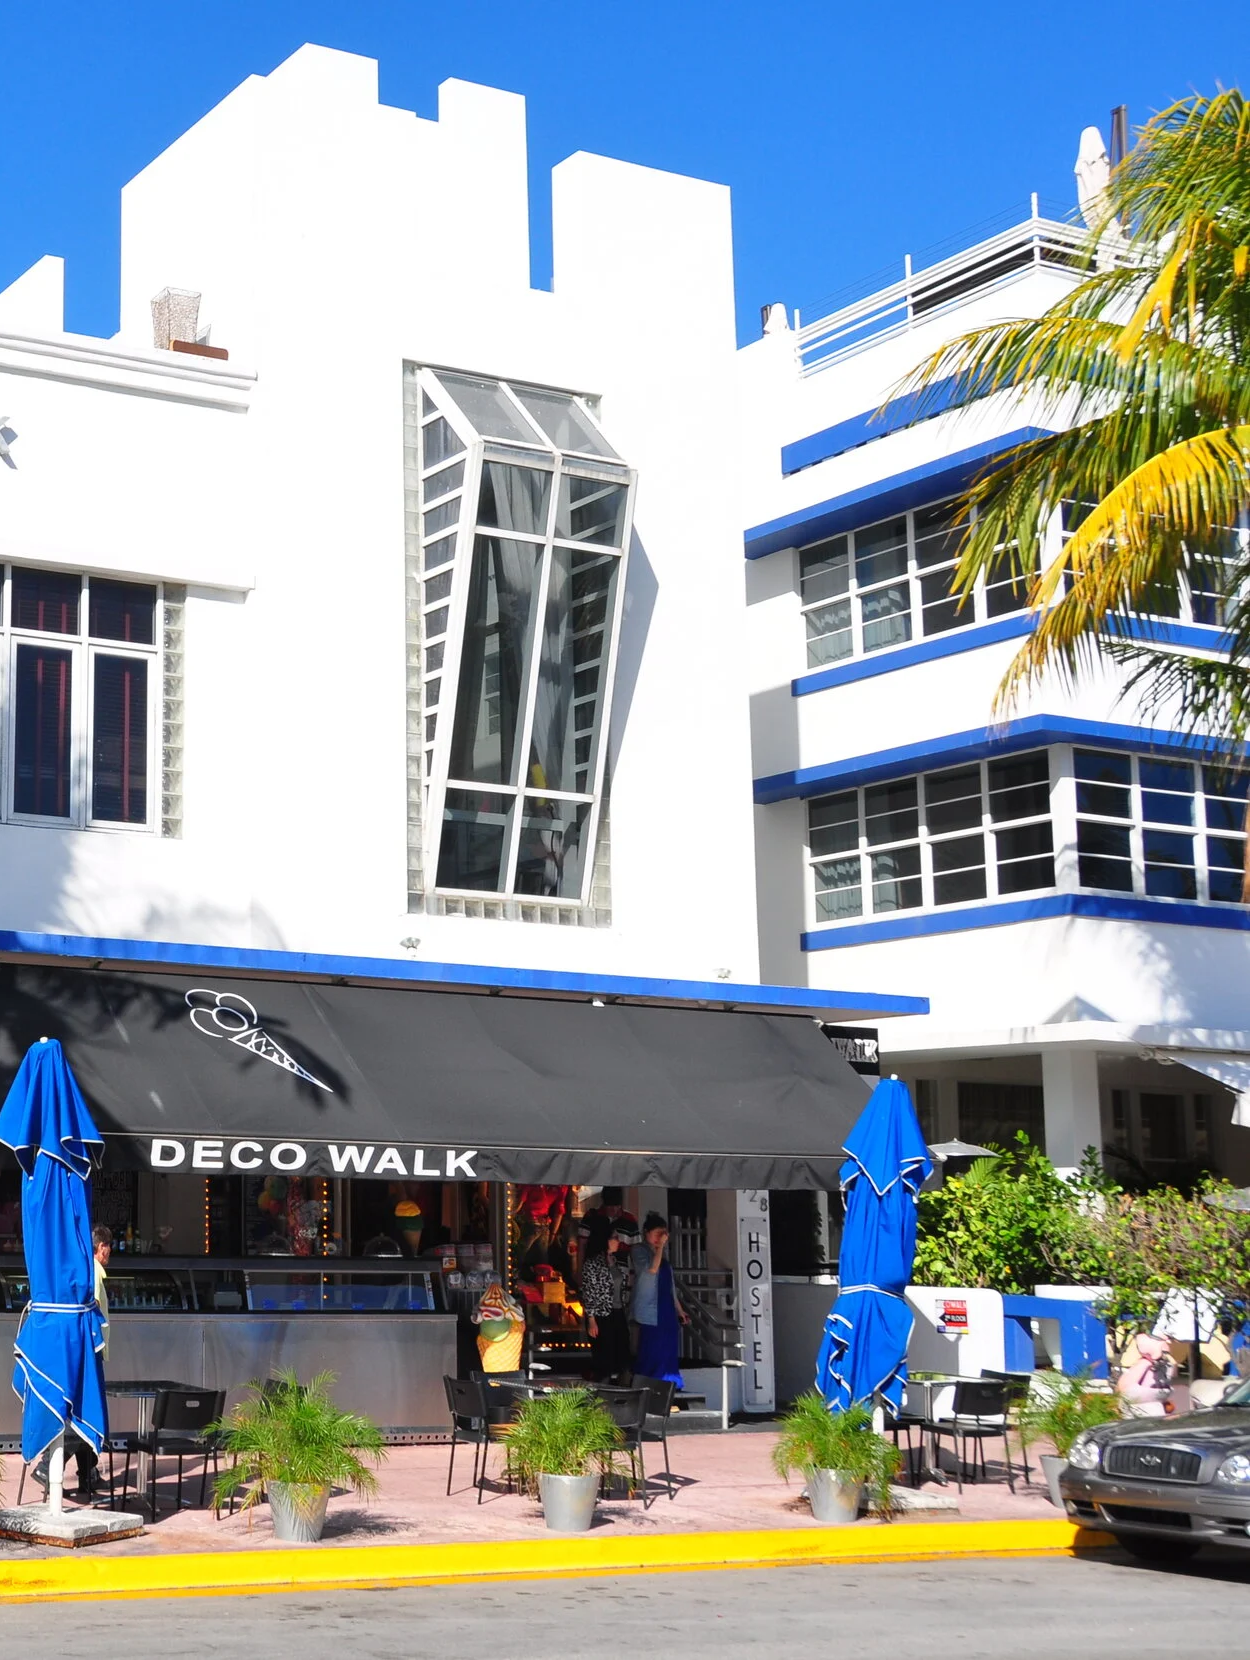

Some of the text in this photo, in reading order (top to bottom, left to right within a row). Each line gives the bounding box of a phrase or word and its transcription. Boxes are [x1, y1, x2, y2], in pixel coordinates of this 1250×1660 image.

[150, 1138, 478, 1178] DECO WALK
[746, 1232, 764, 1390] HOSTEL
